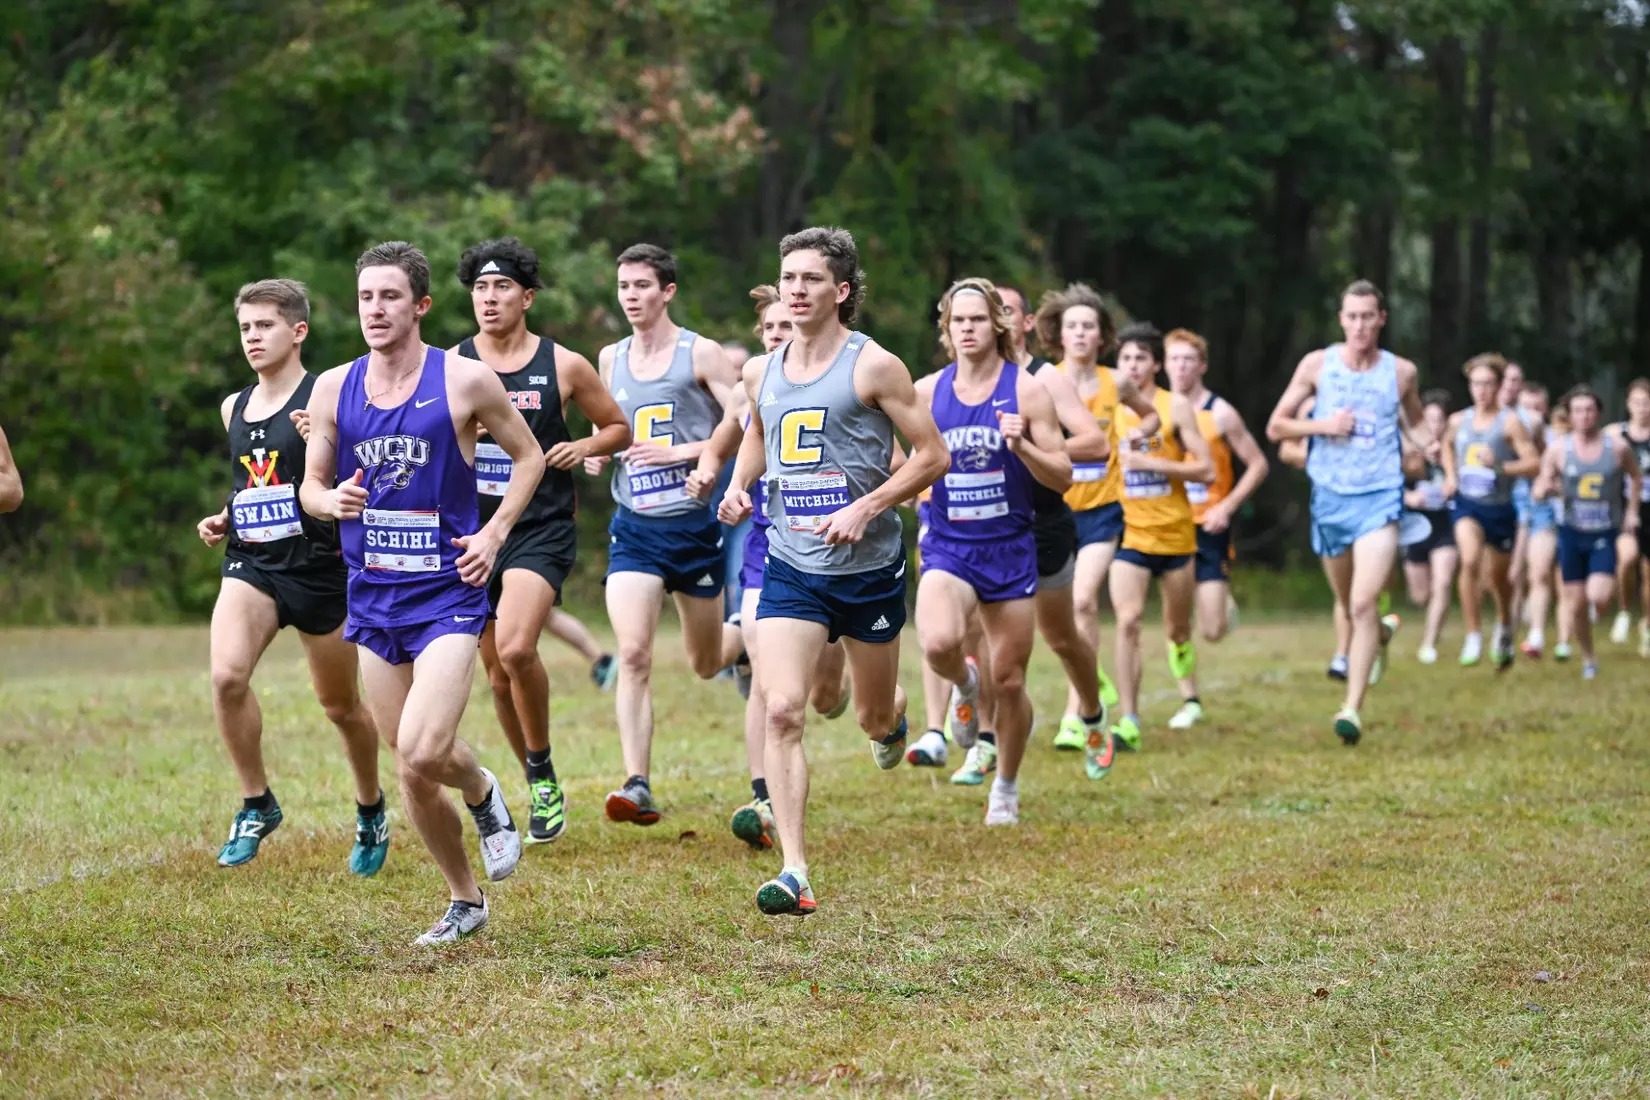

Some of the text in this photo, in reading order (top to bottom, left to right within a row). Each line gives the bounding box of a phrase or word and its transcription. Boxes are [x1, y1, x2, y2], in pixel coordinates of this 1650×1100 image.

[507, 391, 542, 409] CER
[633, 402, 675, 447] C
[779, 406, 829, 467] C
[943, 425, 1002, 453] WCU
[353, 435, 430, 469] WCU
[477, 462, 512, 475] DRIGU
[631, 467, 687, 492] BROWN
[948, 487, 1004, 502] MITCHELL
[1577, 472, 1604, 499] C
[784, 493, 848, 508] MITCHELL
[234, 501, 295, 525] SWAIN
[366, 529, 437, 549] SCHIHL
